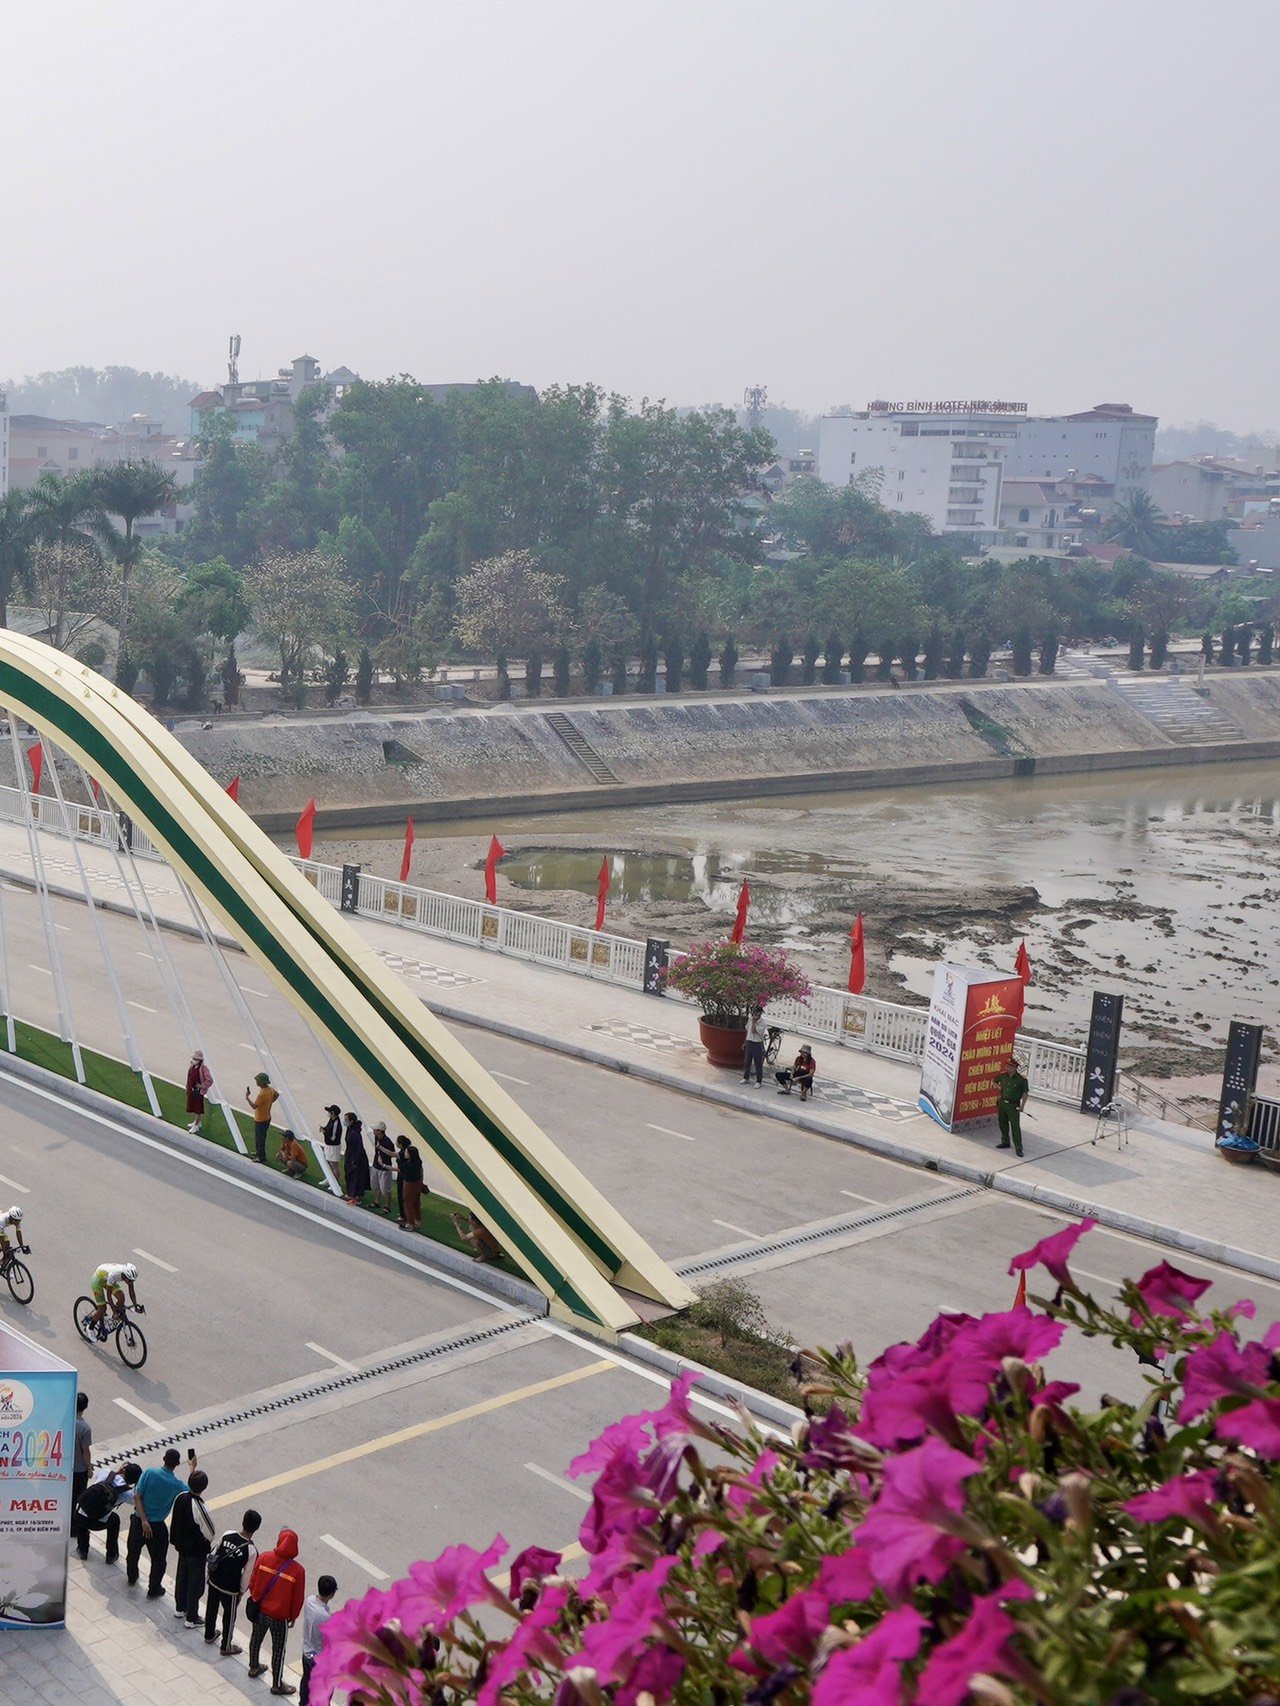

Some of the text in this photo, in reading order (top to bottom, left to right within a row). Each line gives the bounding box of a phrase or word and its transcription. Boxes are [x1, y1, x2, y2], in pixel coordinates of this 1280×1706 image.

[929, 1037, 955, 1062] 2024
[11, 1430, 62, 1467] 2024
[9, 1499, 58, 1514] MẠC
